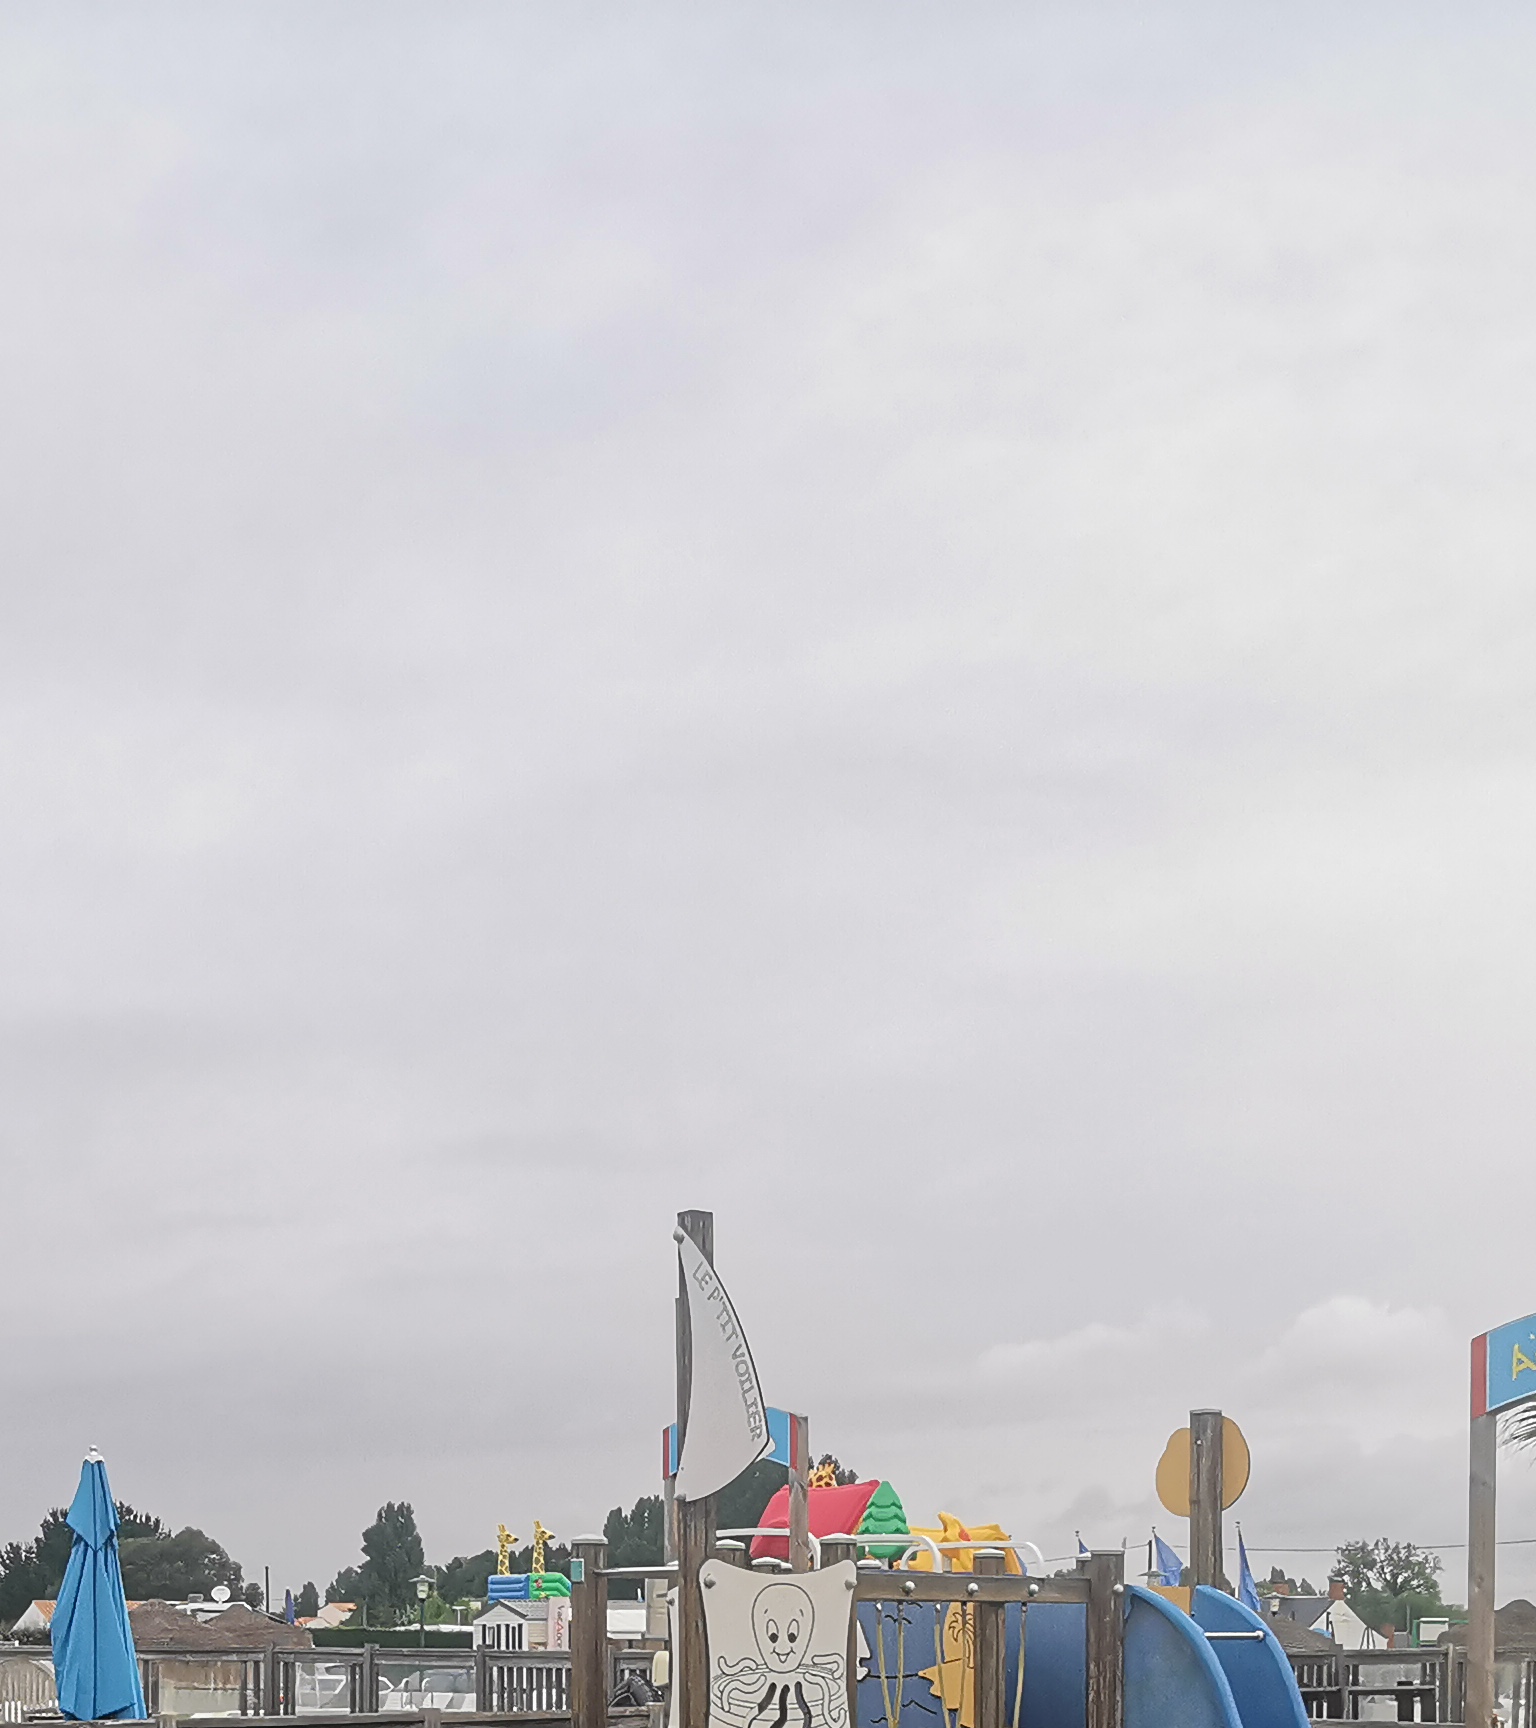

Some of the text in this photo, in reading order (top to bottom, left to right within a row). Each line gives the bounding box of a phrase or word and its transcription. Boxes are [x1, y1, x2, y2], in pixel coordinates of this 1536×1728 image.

[692, 1260, 763, 1442] LE P'TIT VOILIER
